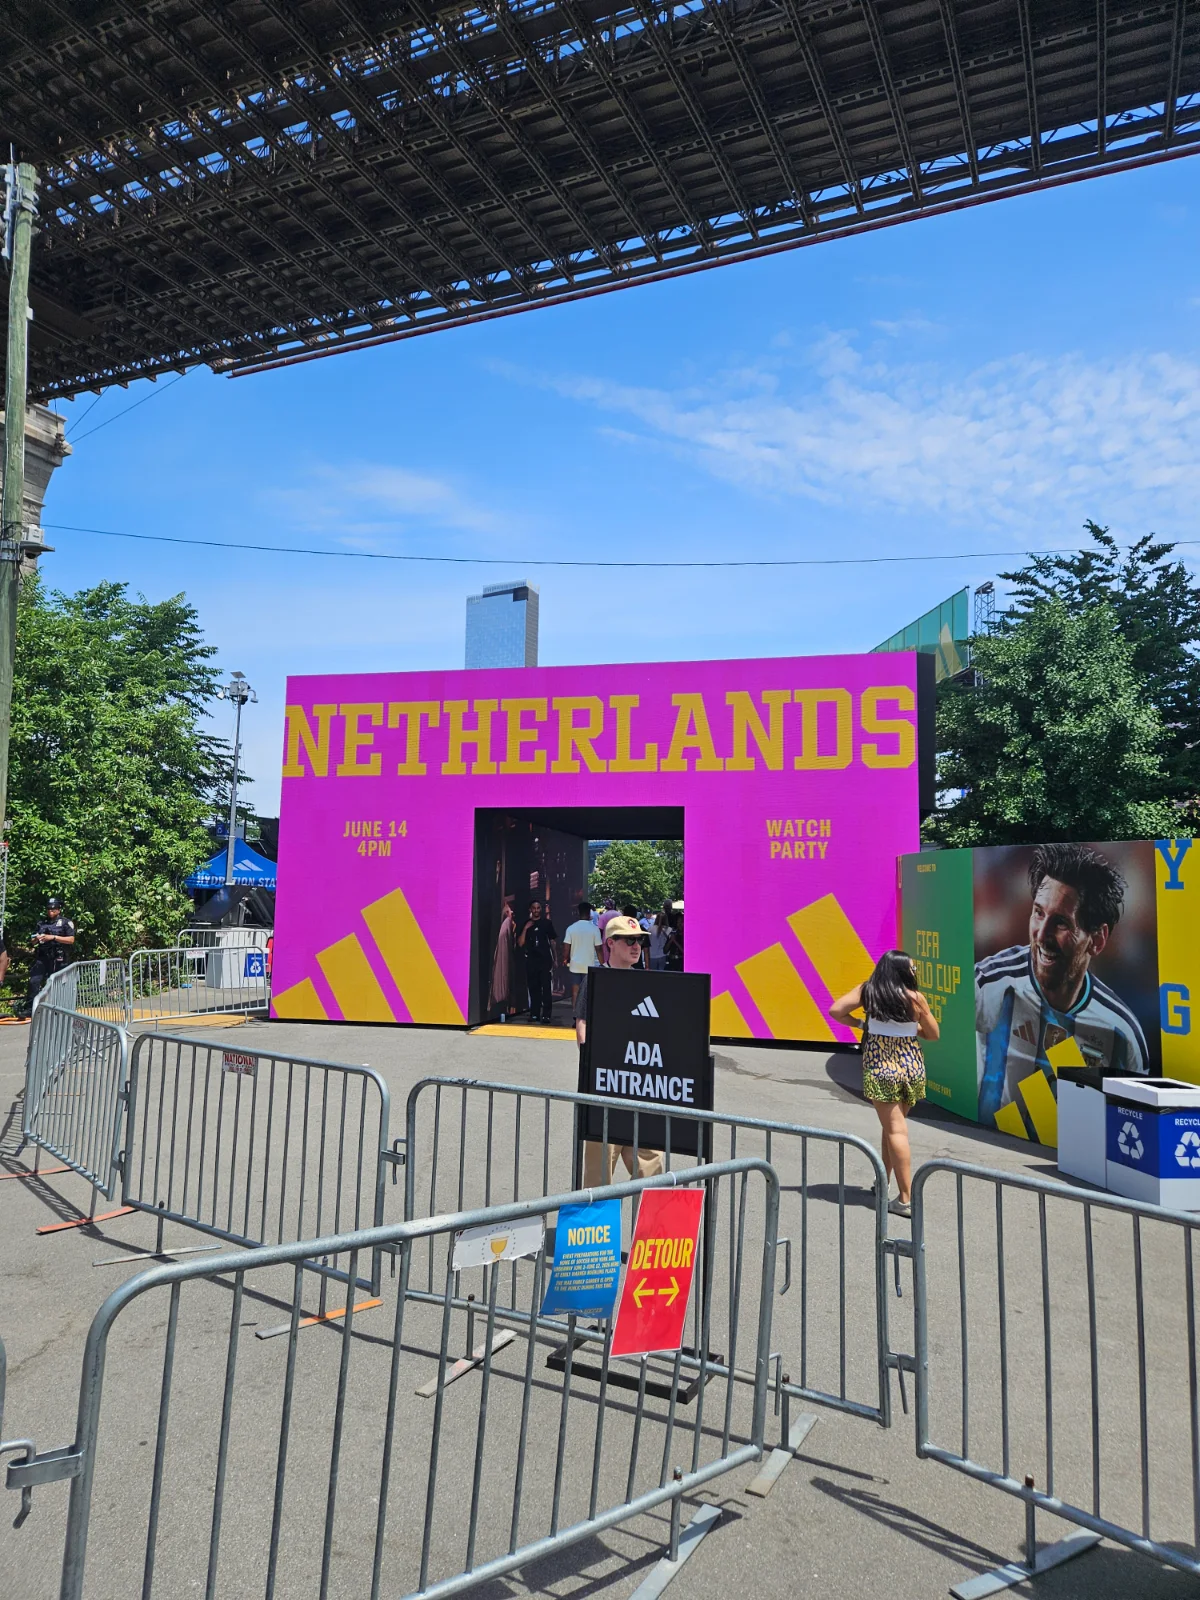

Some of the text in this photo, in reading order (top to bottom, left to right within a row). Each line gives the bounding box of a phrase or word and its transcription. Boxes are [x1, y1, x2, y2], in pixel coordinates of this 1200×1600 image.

[282, 685, 916, 777] NETHERLANDS
[343, 820, 408, 837] JUNE 14
[766, 819, 831, 837] WATCH
[357, 840, 391, 857] 4PM
[770, 841, 828, 859] PARTY
[196, 874, 277, 888] HYDRTION STA
[916, 929, 939, 959] FIFA
[912, 959, 961, 994] RLD CUP
[624, 1041, 663, 1068] ADA
[595, 1067, 694, 1103] ENTRANCE
[1117, 1106, 1143, 1121] RECYCLE
[1174, 1118, 1200, 1126] RECYCL
[567, 1225, 611, 1247] NOTICE
[631, 1238, 694, 1270] DETOUR
